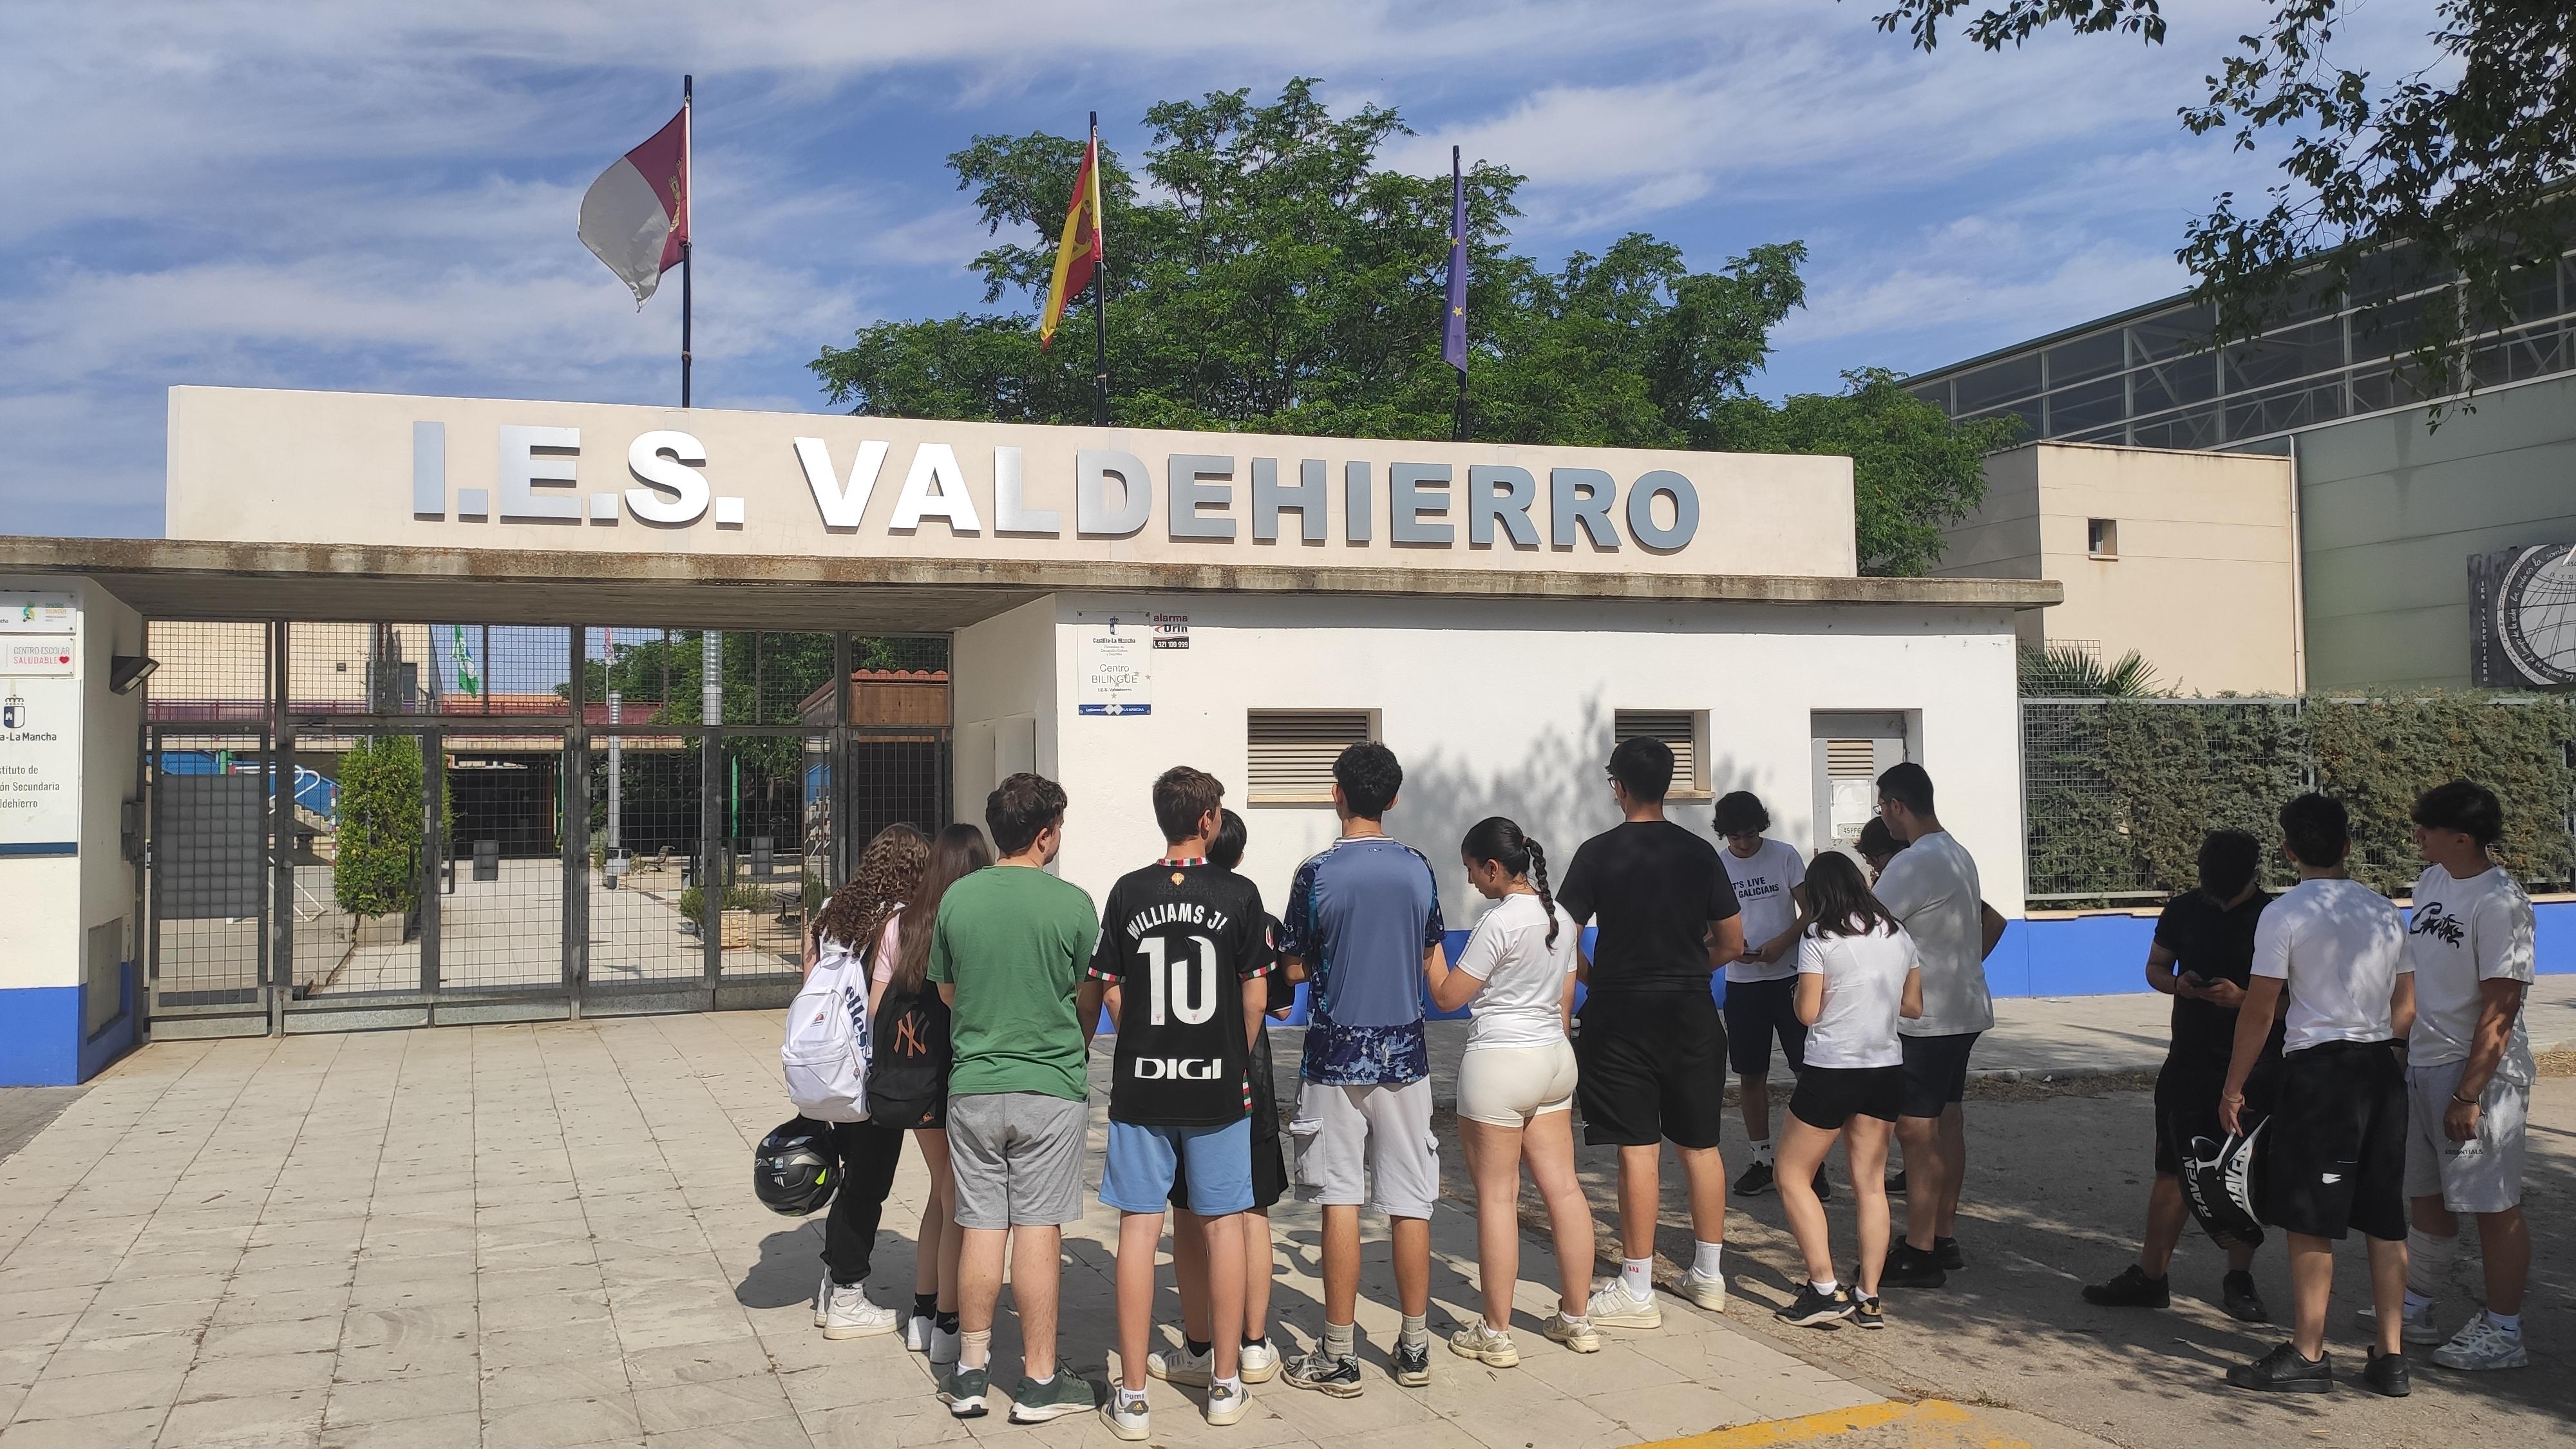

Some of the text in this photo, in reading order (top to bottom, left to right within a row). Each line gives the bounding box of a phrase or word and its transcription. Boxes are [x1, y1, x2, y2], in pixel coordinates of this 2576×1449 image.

[413, 421, 1700, 550] I.E.S. VALDEHIERRO
[1153, 613, 1188, 623] alarma
[1100, 664, 1130, 672] Centro
[23, 732, 57, 741] Mancha
[28, 764, 39, 775] de
[12, 781, 60, 791] Secundaria
[1747, 876, 1766, 887] LIVE
[1738, 884, 1779, 898] GALICIANS
[1126, 903, 1204, 941] WILLIAMS
[1137, 935, 1217, 1025] 10
[1134, 1057, 1222, 1080] DIGI
